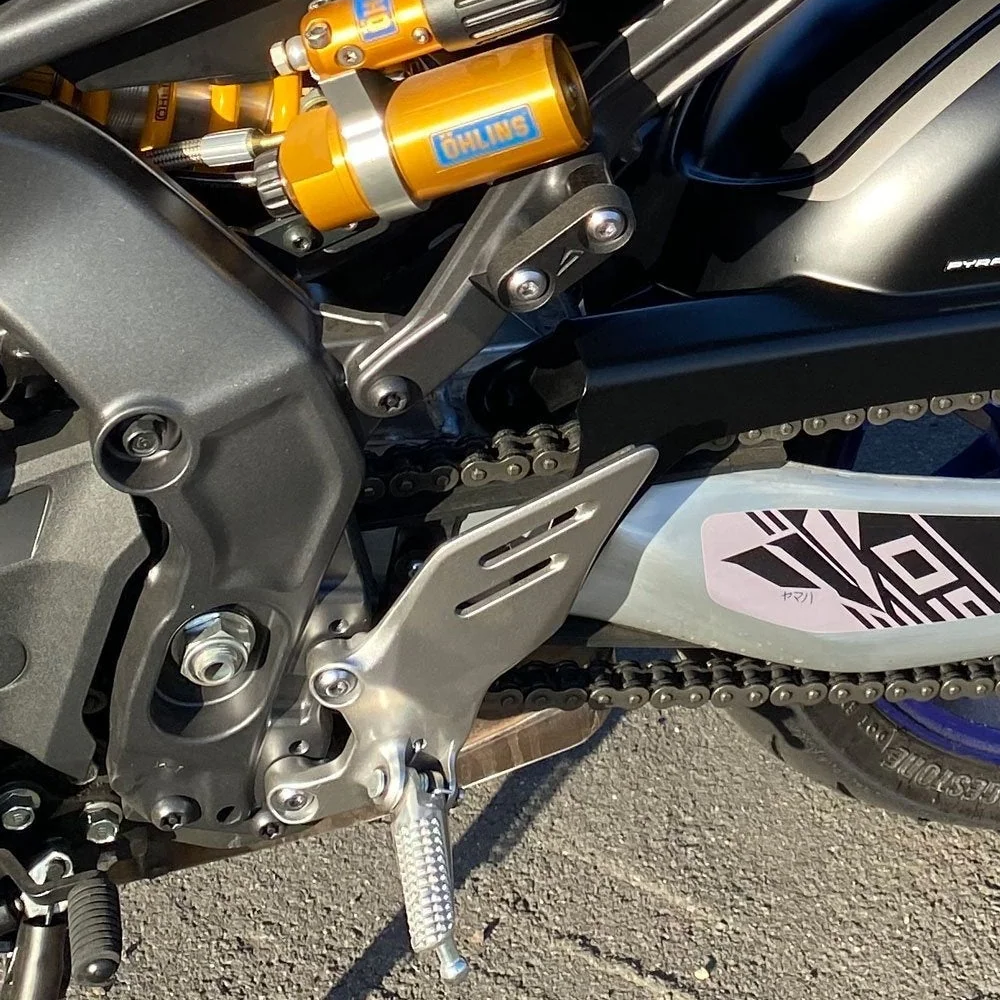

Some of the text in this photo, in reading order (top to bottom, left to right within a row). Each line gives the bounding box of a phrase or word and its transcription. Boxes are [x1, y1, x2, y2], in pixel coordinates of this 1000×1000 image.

[439, 114, 530, 160] ÖHLINS
[781, 591, 814, 605] ヤマハ
